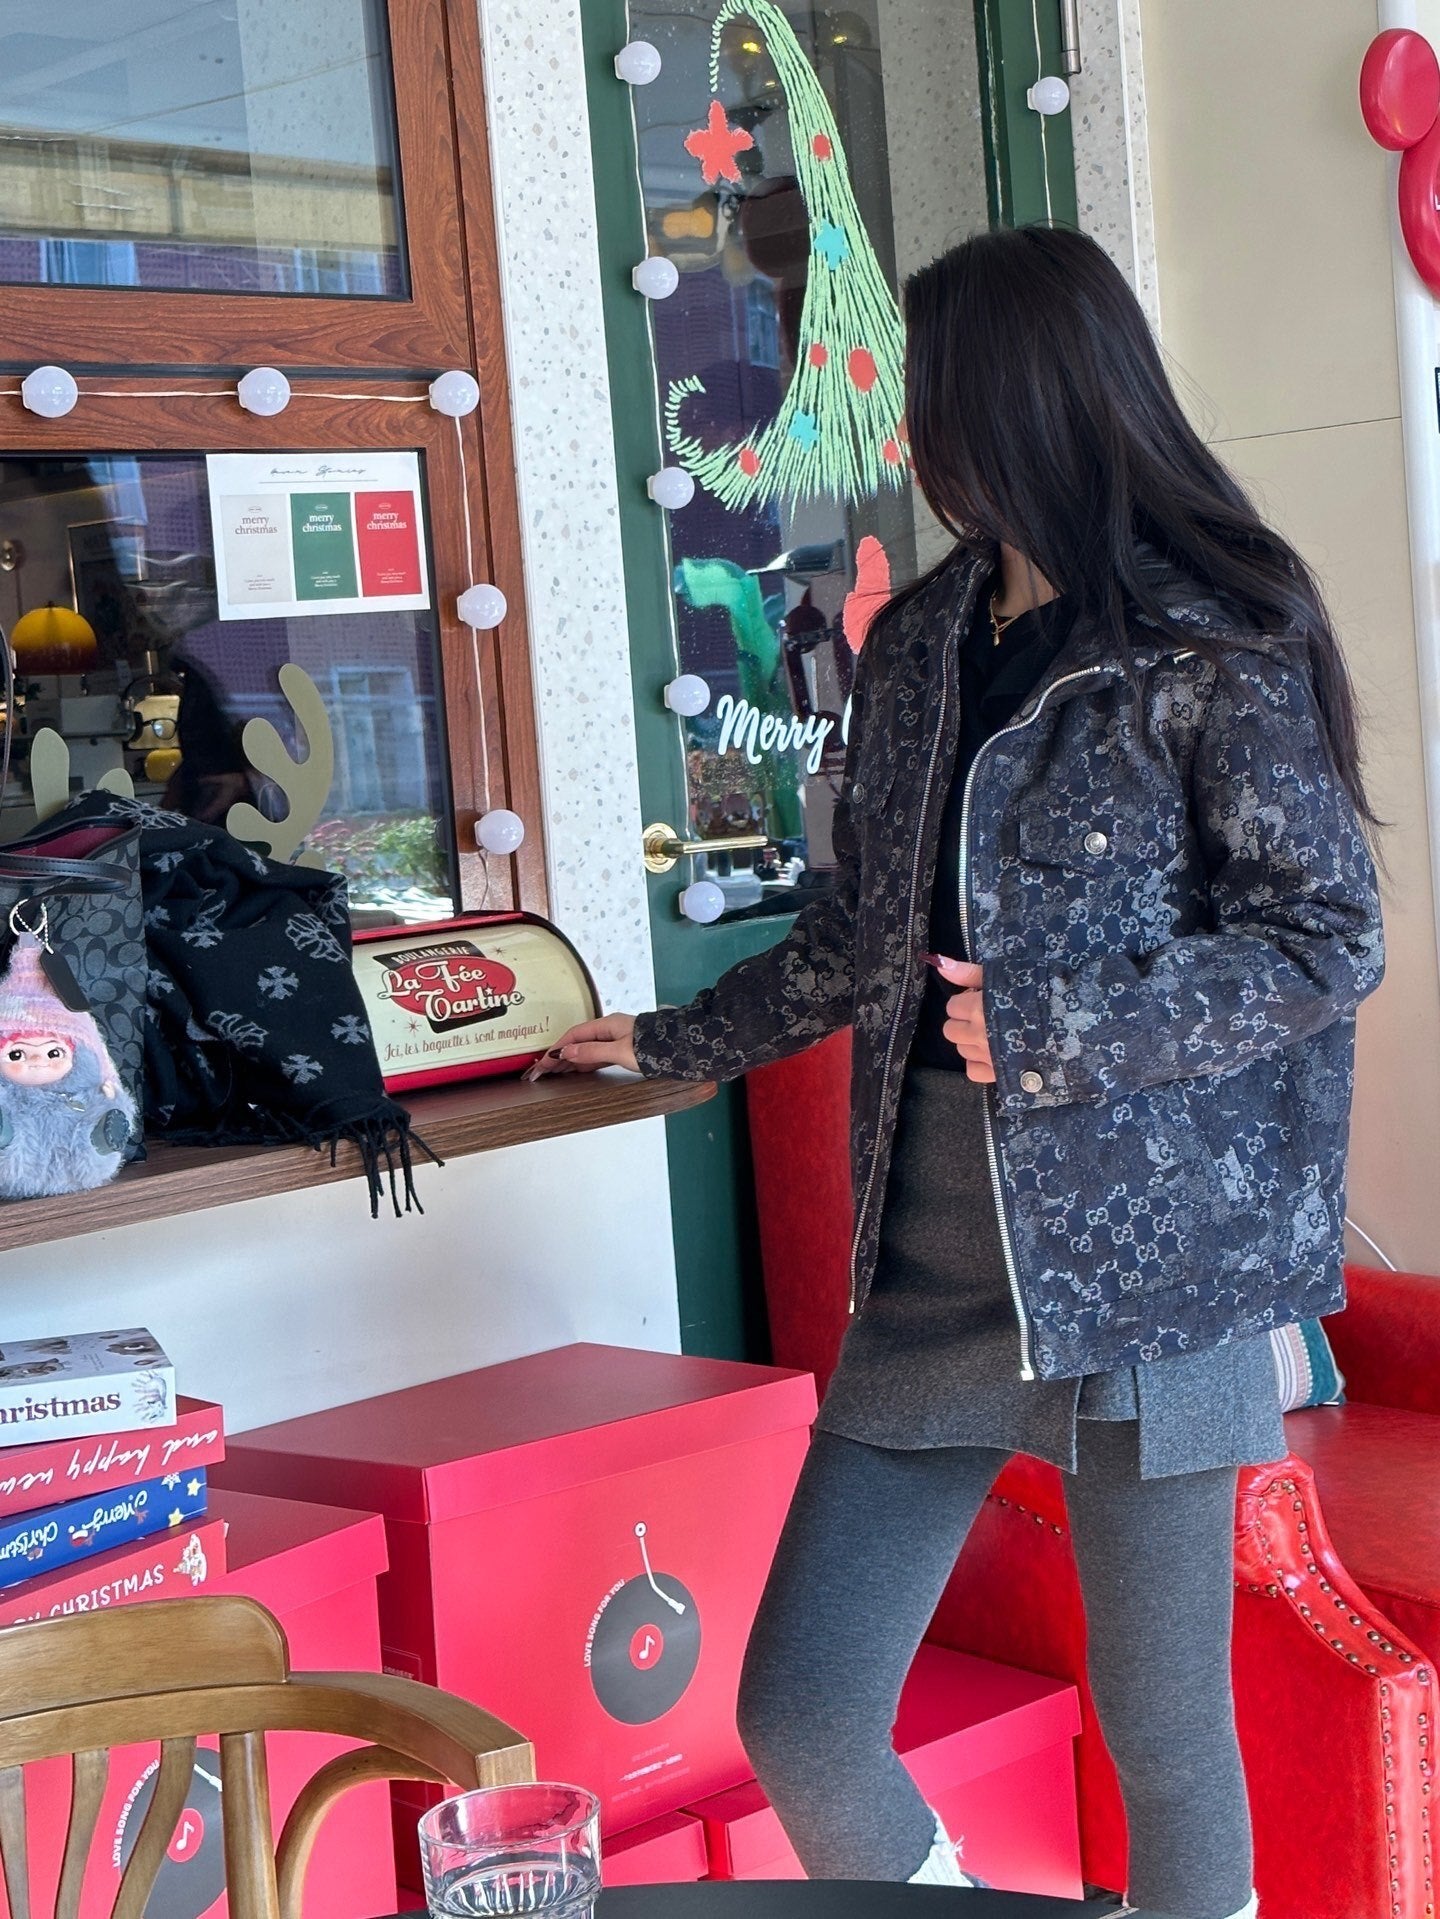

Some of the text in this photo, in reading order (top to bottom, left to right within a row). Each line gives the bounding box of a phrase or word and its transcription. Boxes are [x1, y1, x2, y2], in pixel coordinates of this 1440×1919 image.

[235, 525, 278, 535] christmas
[242, 516, 269, 526] merry
[302, 523, 342, 532] christmas
[309, 514, 334, 525] merry
[366, 520, 407, 530] christmas
[373, 512, 399, 521] merry
[716, 694, 835, 775] Merry
[391, 946, 470, 964] BOULANGERIE
[378, 960, 486, 999] La Fée
[415, 985, 525, 1022] Tartine
[405, 1042, 419, 1056] les
[422, 1034, 470, 1053] baguettes
[474, 1028, 496, 1043] sont
[67, 1440, 151, 1481] happy
[161, 1429, 218, 1466] and
[82, 1490, 148, 1533] Merry
[583, 1578, 626, 1668] LOVE SONG FOR YOU
[112, 1759, 160, 1868] LOVE SONG FOR YOU
